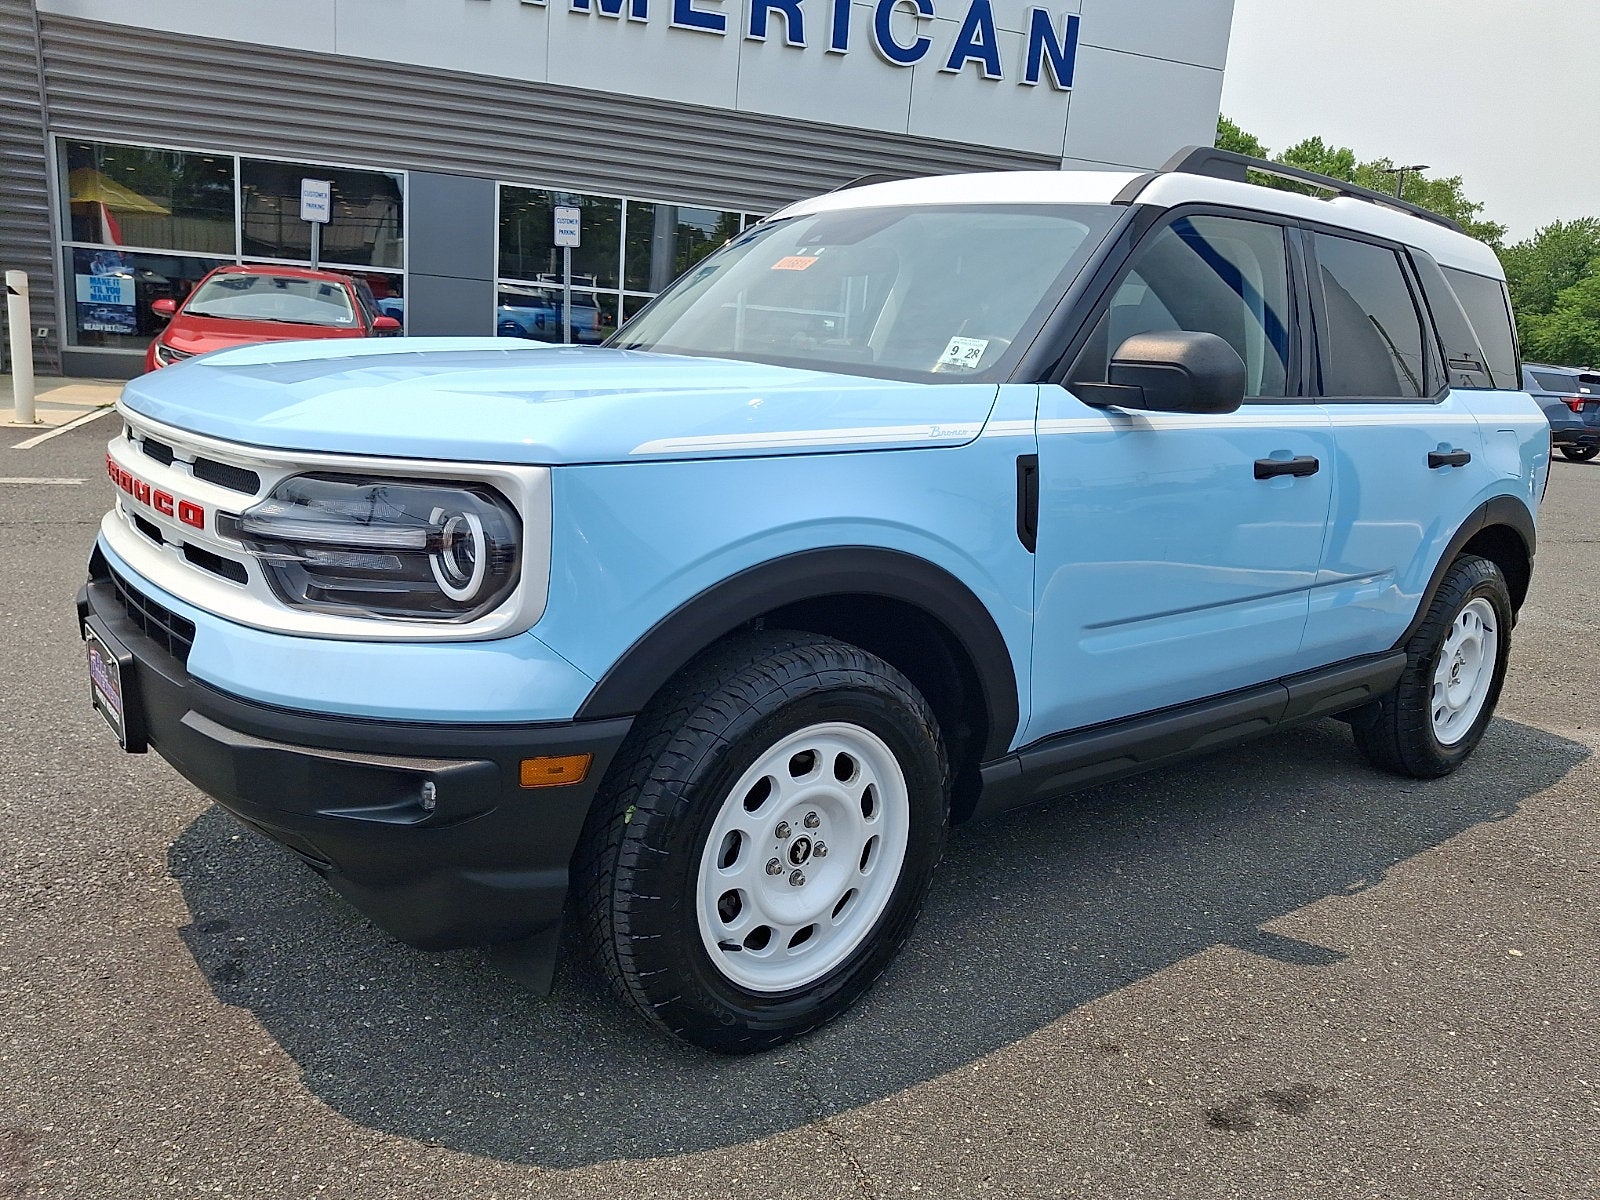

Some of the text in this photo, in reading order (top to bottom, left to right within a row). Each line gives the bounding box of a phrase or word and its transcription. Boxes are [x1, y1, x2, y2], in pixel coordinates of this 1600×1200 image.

[474, 0, 1080, 92] RICAN
[304, 191, 328, 199] CUSTOMER
[305, 202, 325, 210] PARKING
[557, 217, 578, 225] CUSTOMER
[106, 286, 121, 295] YOU
[950, 345, 980, 359] 9 28
[928, 425, 969, 438] Bronco
[106, 454, 205, 530] RONCO
